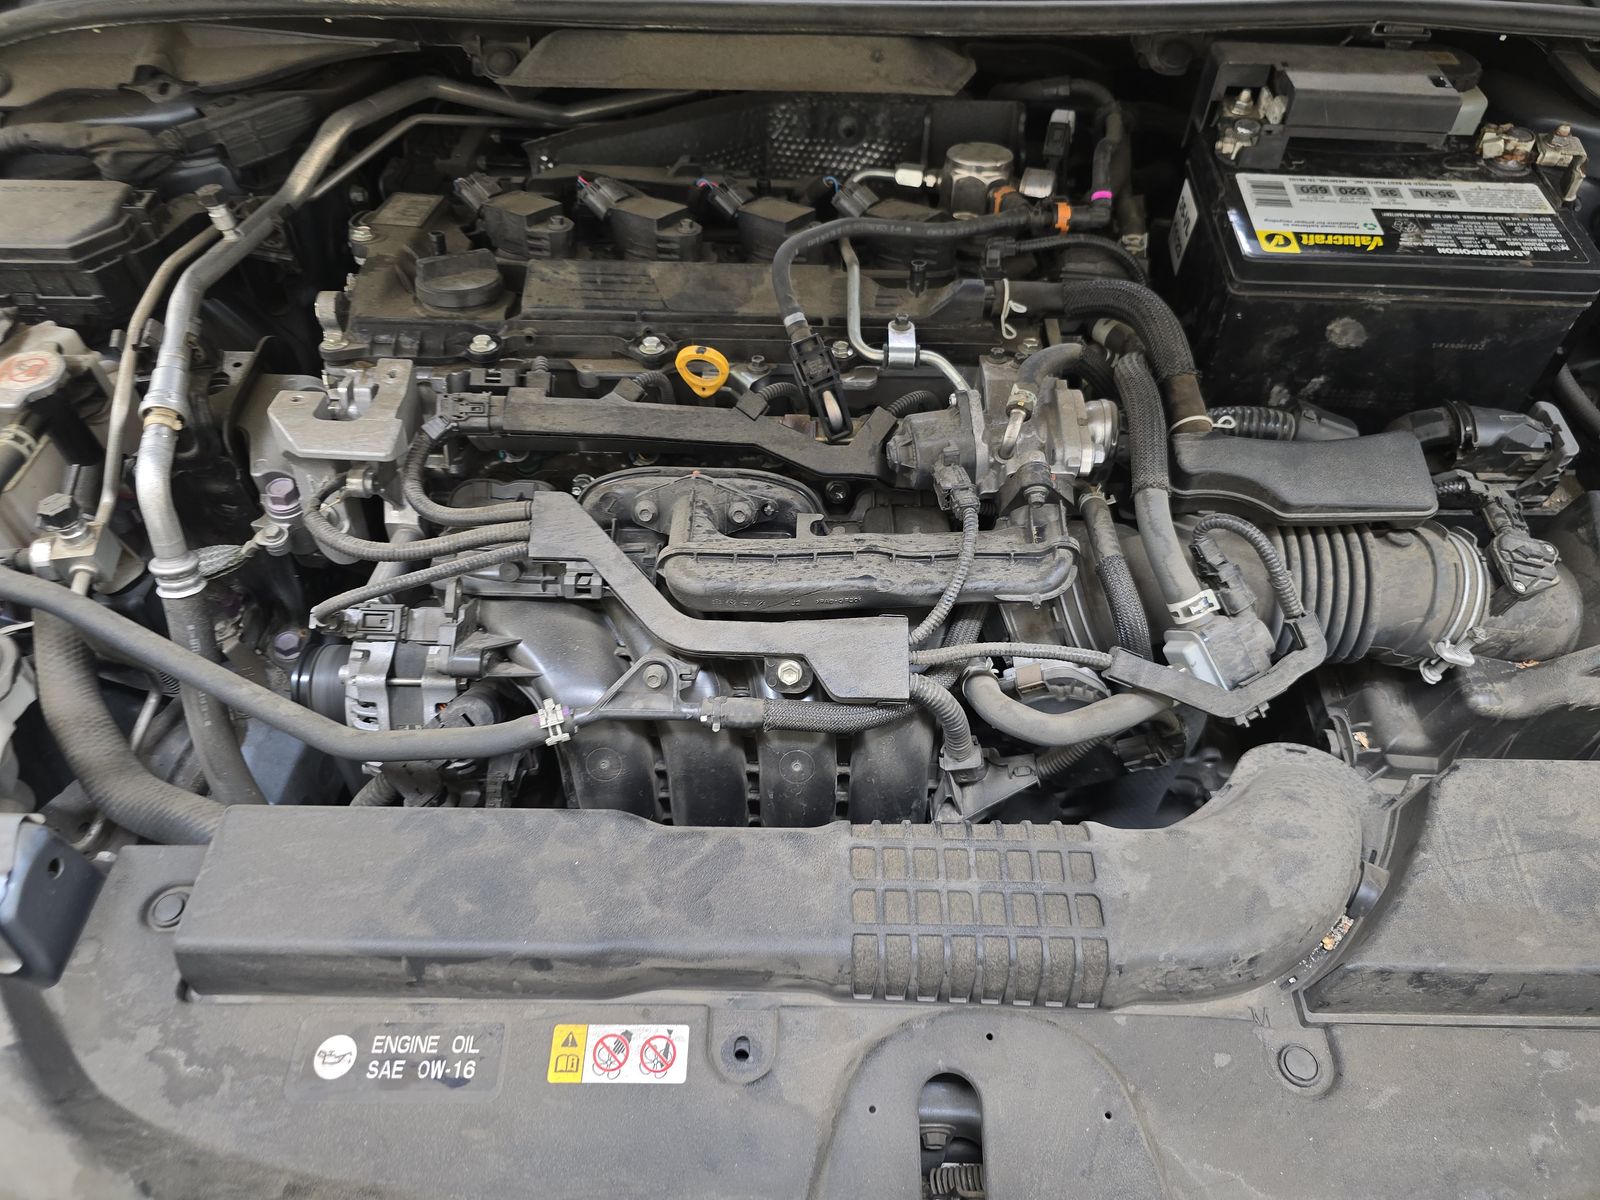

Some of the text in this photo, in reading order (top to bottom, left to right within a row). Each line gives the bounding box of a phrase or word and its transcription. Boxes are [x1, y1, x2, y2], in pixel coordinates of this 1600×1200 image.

[1301, 186, 1328, 195] 650
[1339, 188, 1367, 196] 520
[1414, 191, 1455, 199] 35-VL
[1301, 233, 1384, 252] Valucraft
[371, 1035, 480, 1055] ENGINE OIL
[366, 1060, 476, 1080] SAE 0W-16
